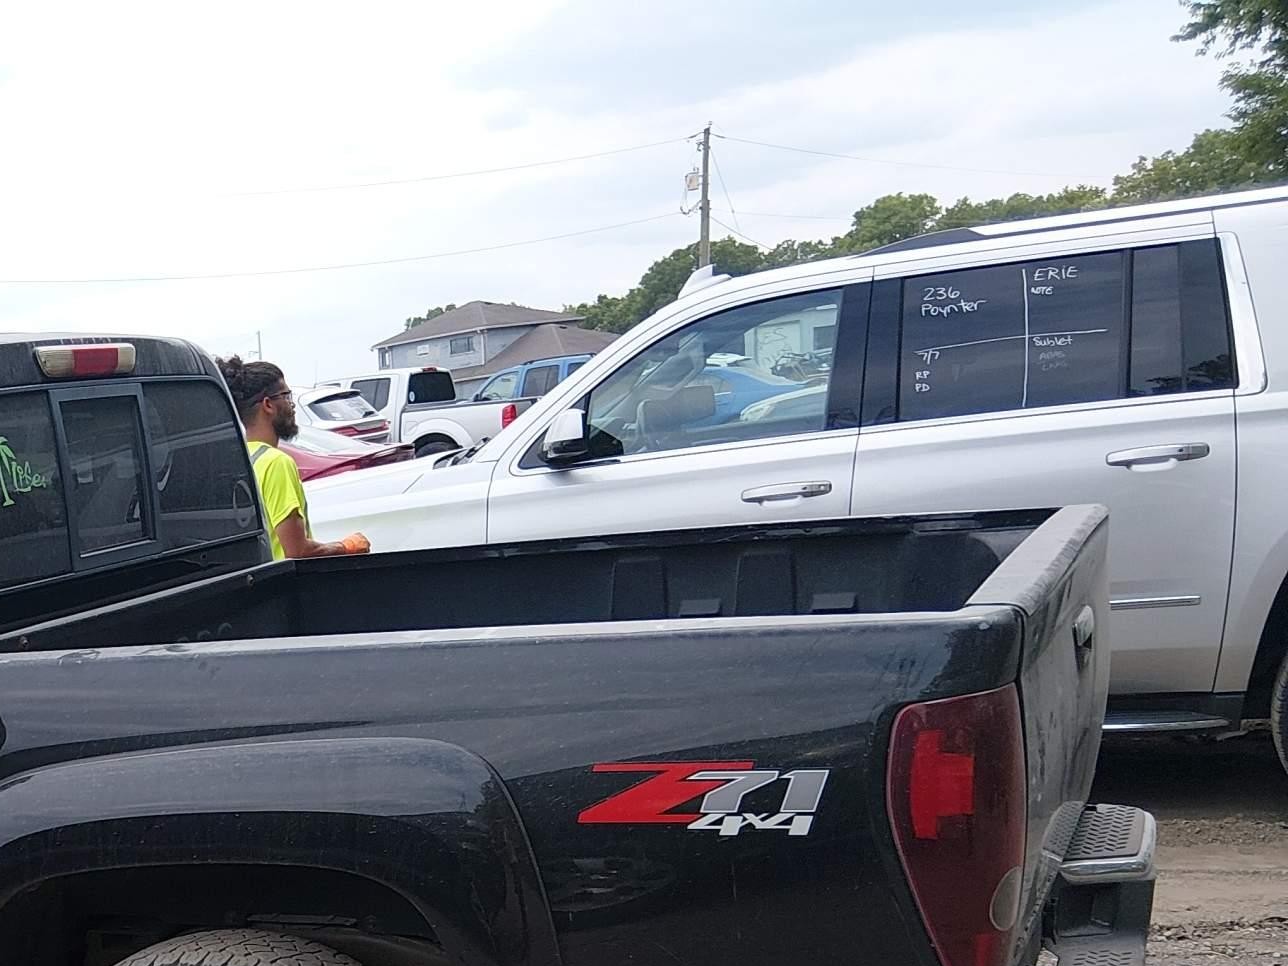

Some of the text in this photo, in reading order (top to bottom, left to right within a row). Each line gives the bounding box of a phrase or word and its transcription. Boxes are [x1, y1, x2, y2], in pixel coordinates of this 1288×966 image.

[1032, 265, 1079, 281] ERIE
[923, 286, 961, 301] 236
[921, 299, 987, 318] Poynter
[1032, 335, 1073, 347] Sublet
[577, 760, 831, 824] Z71
